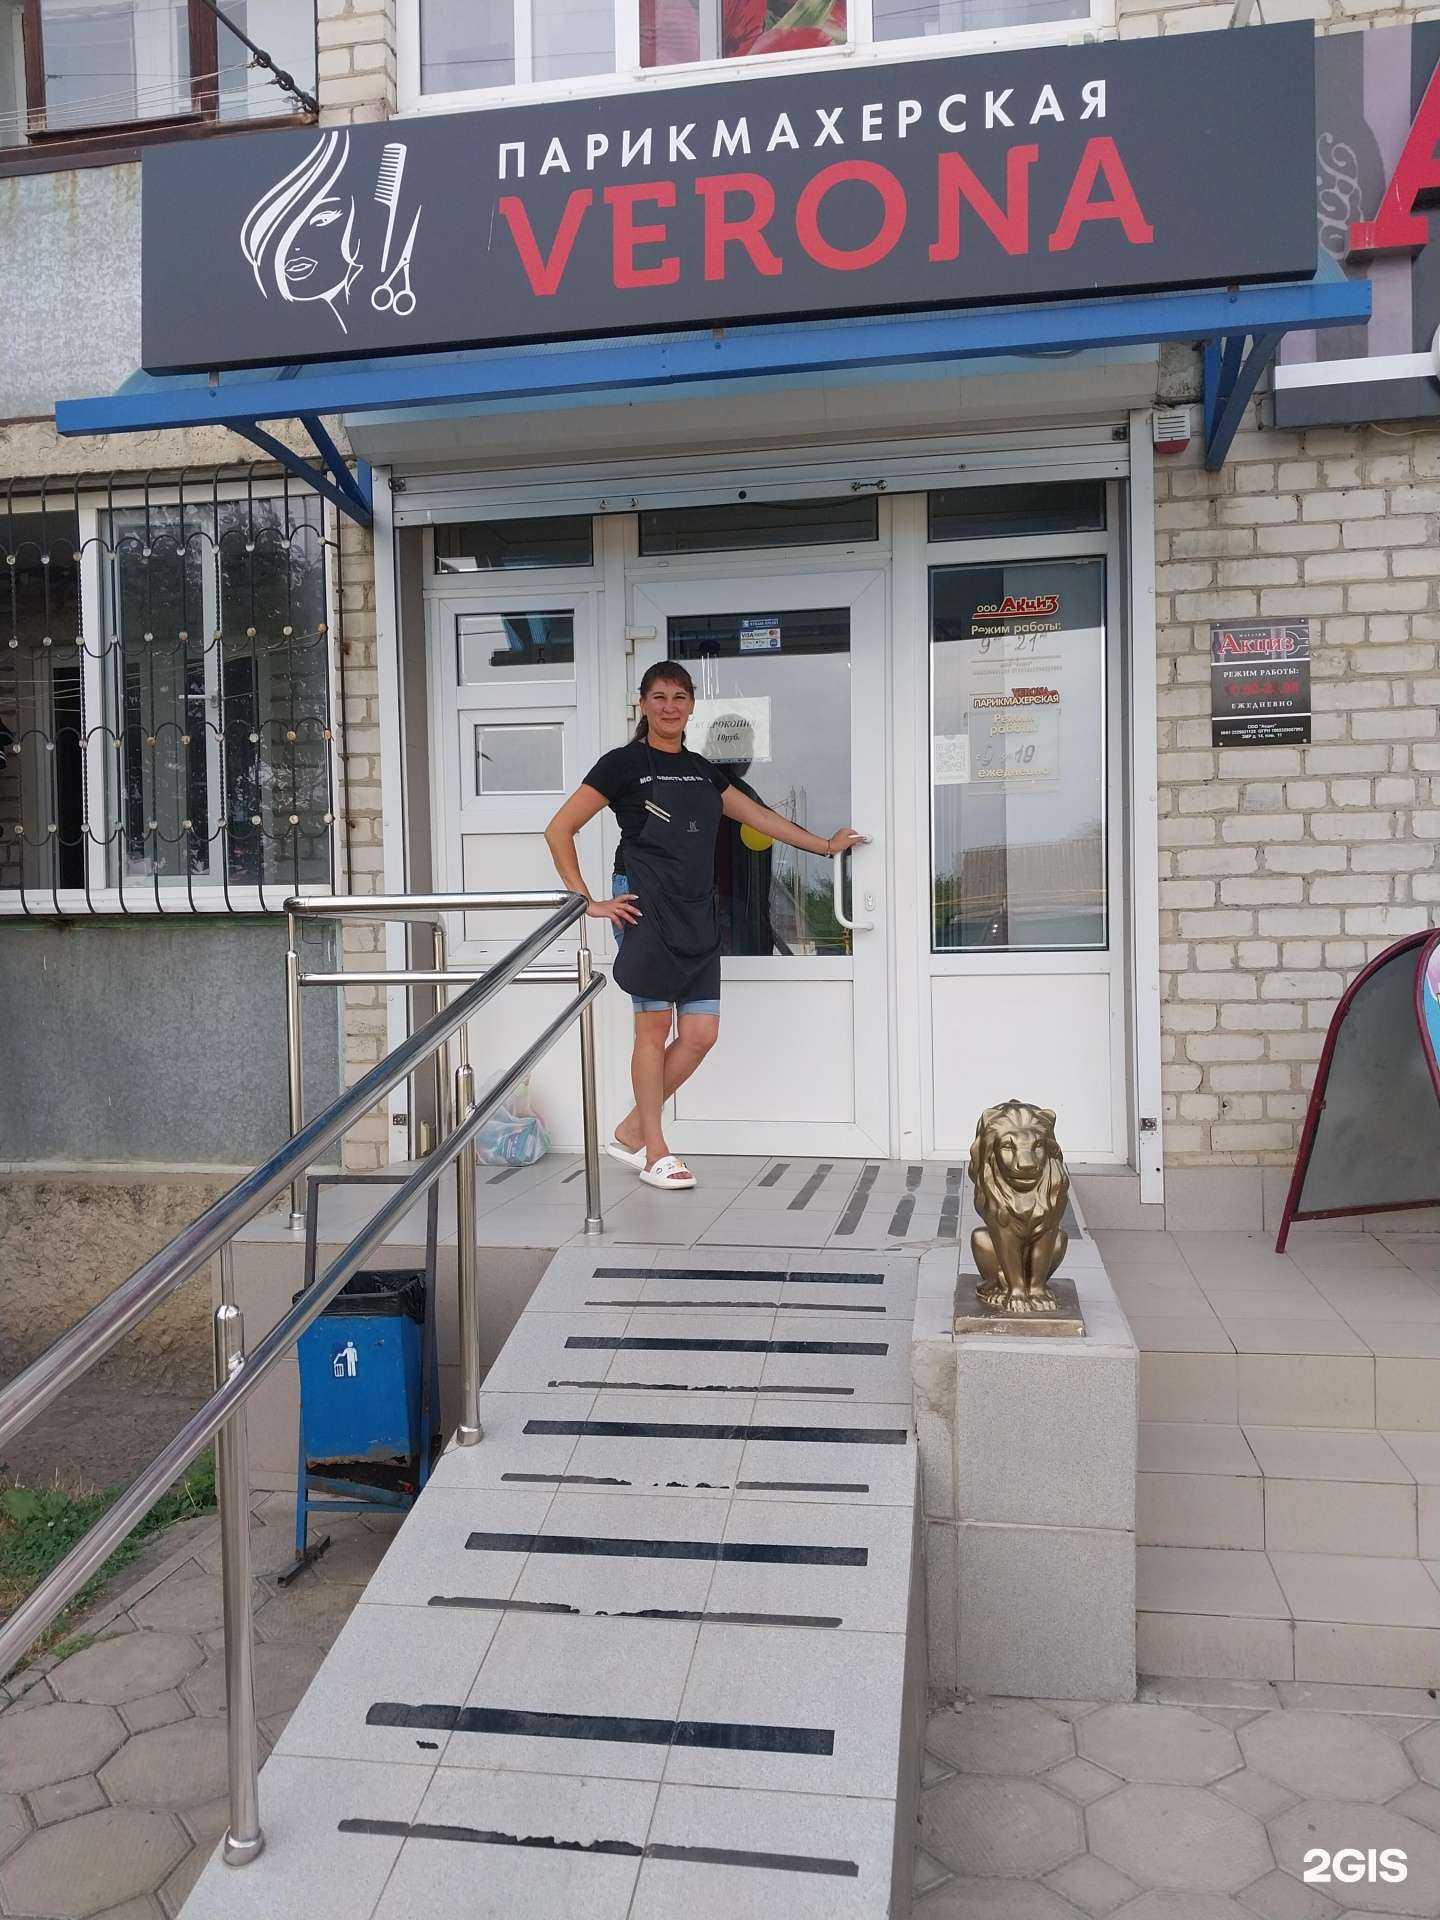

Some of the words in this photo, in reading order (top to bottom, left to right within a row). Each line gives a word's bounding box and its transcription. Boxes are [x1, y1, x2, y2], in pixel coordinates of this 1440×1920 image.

[497, 79, 1107, 180] ПАРИКМАХЕРСКАЯ
[499, 136, 1154, 296] VERONA
[999, 594, 1060, 614] Акциз
[971, 625, 1010, 636] Режим
[1014, 620, 1062, 635] работы:
[1217, 631, 1295, 656] Акциз
[1223, 670, 1257, 678] РЕЖИМ
[1260, 667, 1300, 676] РАБОТЫ:
[973, 695, 1060, 708] ПАРИКМАХЕРСКАЯ
[1231, 700, 1293, 709] ЕЖЕДНЕВНО
